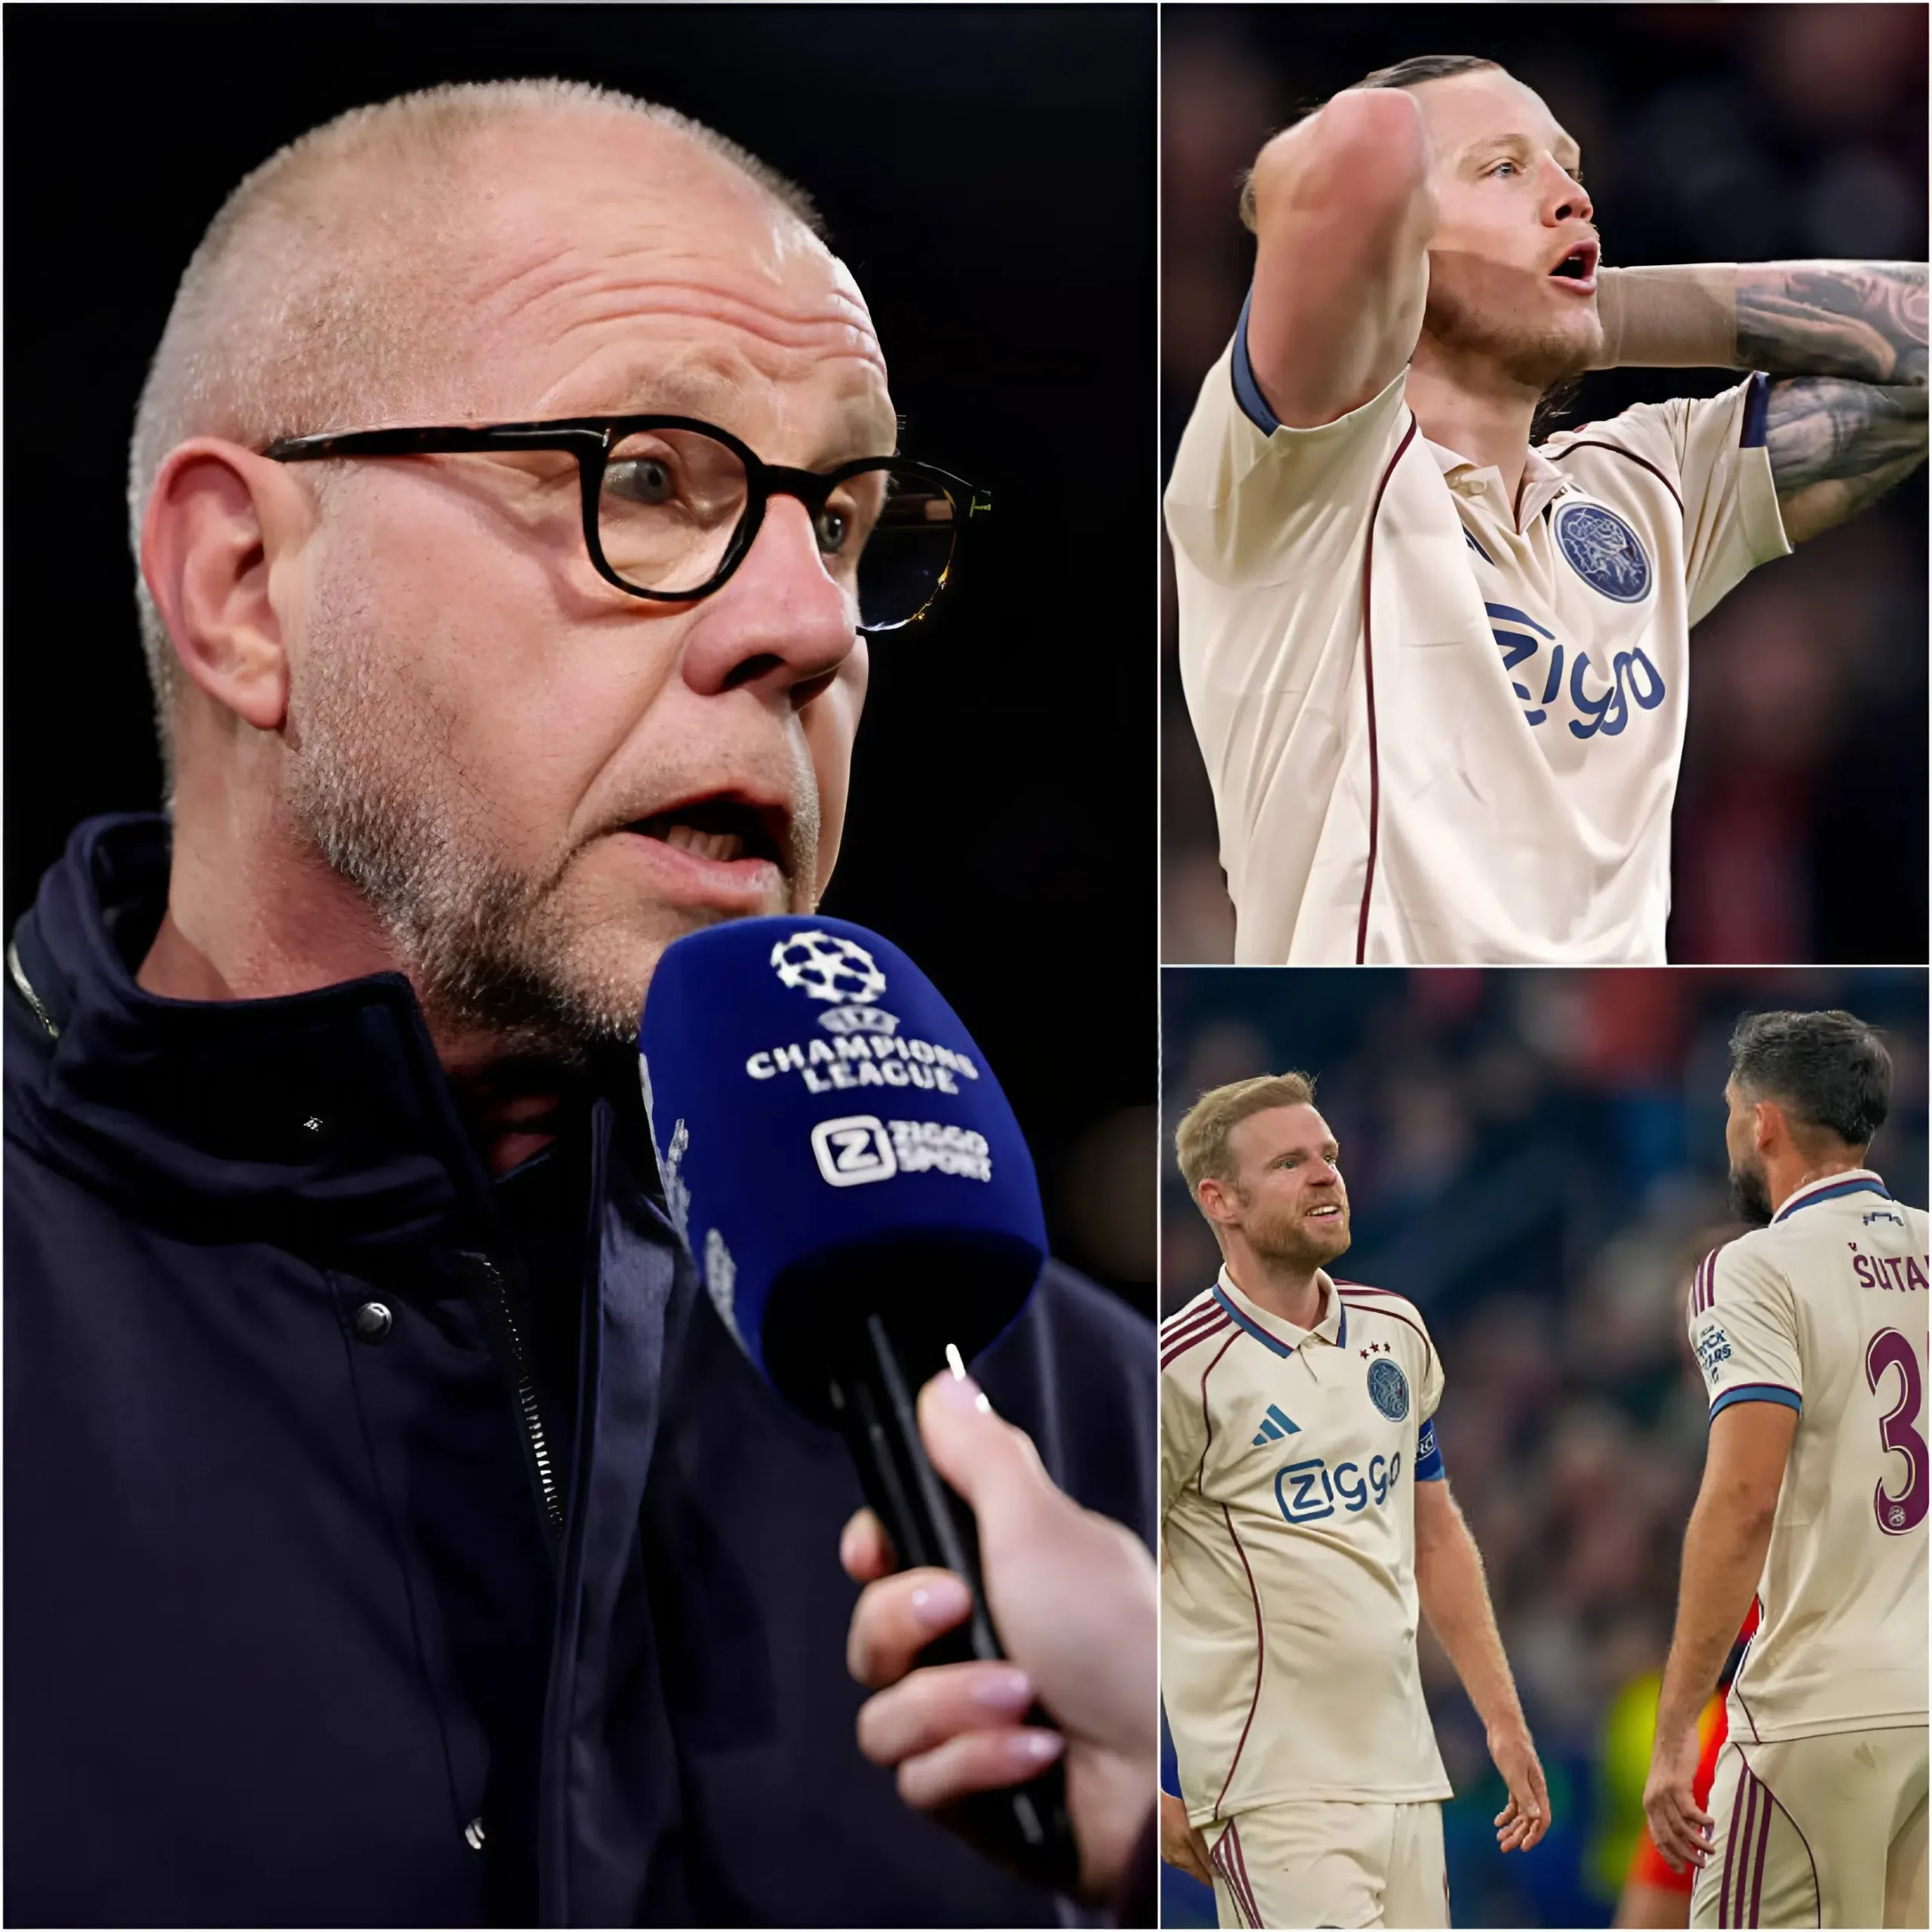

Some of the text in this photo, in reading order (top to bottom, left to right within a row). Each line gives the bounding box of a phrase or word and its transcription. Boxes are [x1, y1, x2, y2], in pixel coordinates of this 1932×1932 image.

[746, 1035, 979, 1080] CHAMPIONS
[802, 1059, 960, 1095] LEAGUE
[1847, 1241, 1930, 1293] ŠUTA
[1866, 1326, 1930, 1536] 3
